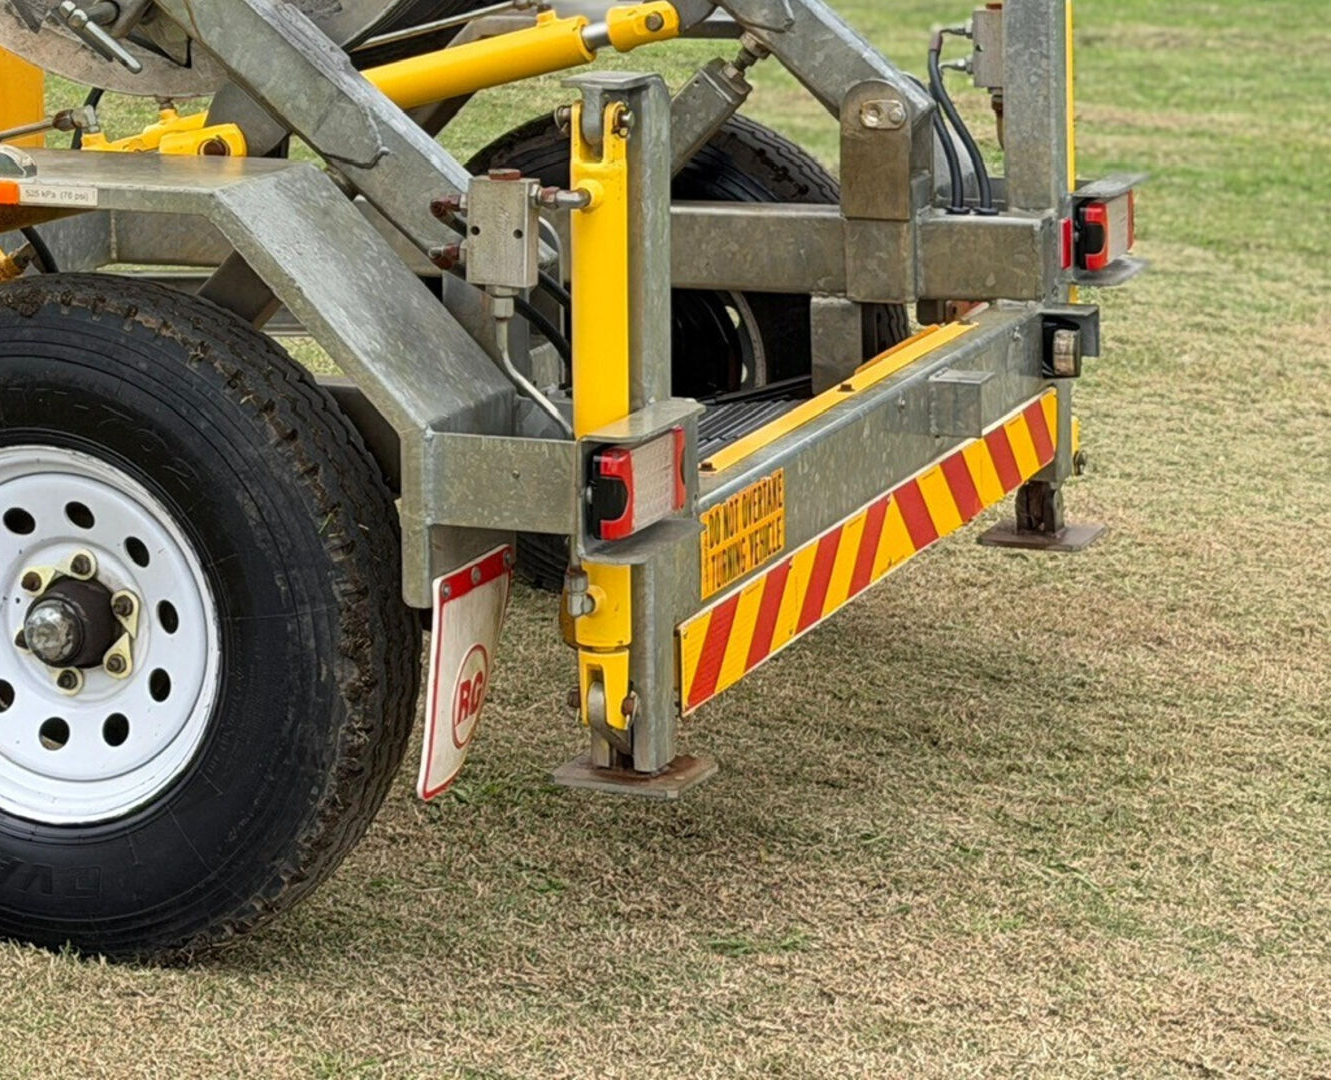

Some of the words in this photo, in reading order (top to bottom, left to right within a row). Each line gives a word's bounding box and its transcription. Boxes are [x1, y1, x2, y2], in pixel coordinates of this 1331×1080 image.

[708, 509, 721, 550] DO
[723, 497, 739, 543] NOT
[741, 472, 784, 530] OVERTAKE
[711, 535, 746, 592] TURNING
[748, 515, 782, 571] VEHICLE
[457, 670, 483, 722] RG
